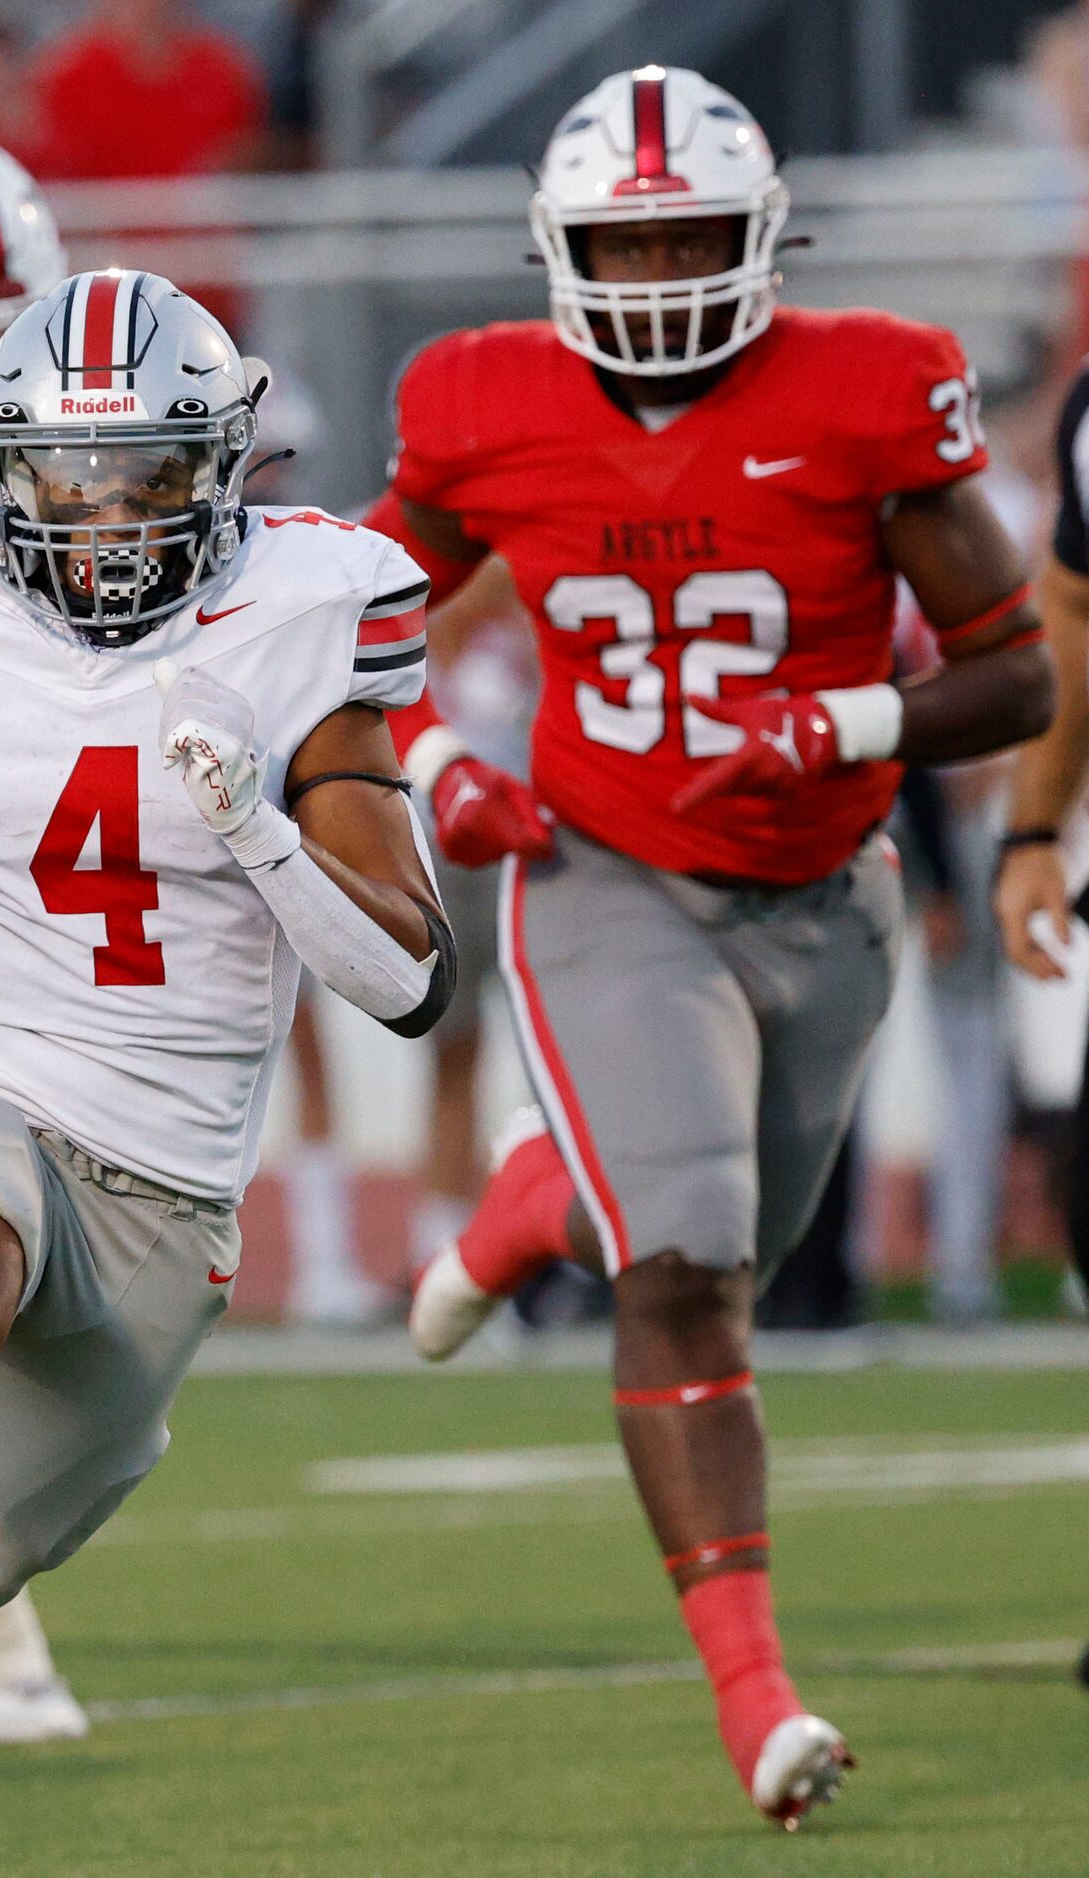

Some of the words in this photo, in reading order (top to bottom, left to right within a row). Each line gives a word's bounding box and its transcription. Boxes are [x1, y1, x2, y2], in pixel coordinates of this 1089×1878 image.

[61, 396, 135, 414] Riddell
[543, 568, 789, 758] 32
[29, 745, 166, 986] 4
